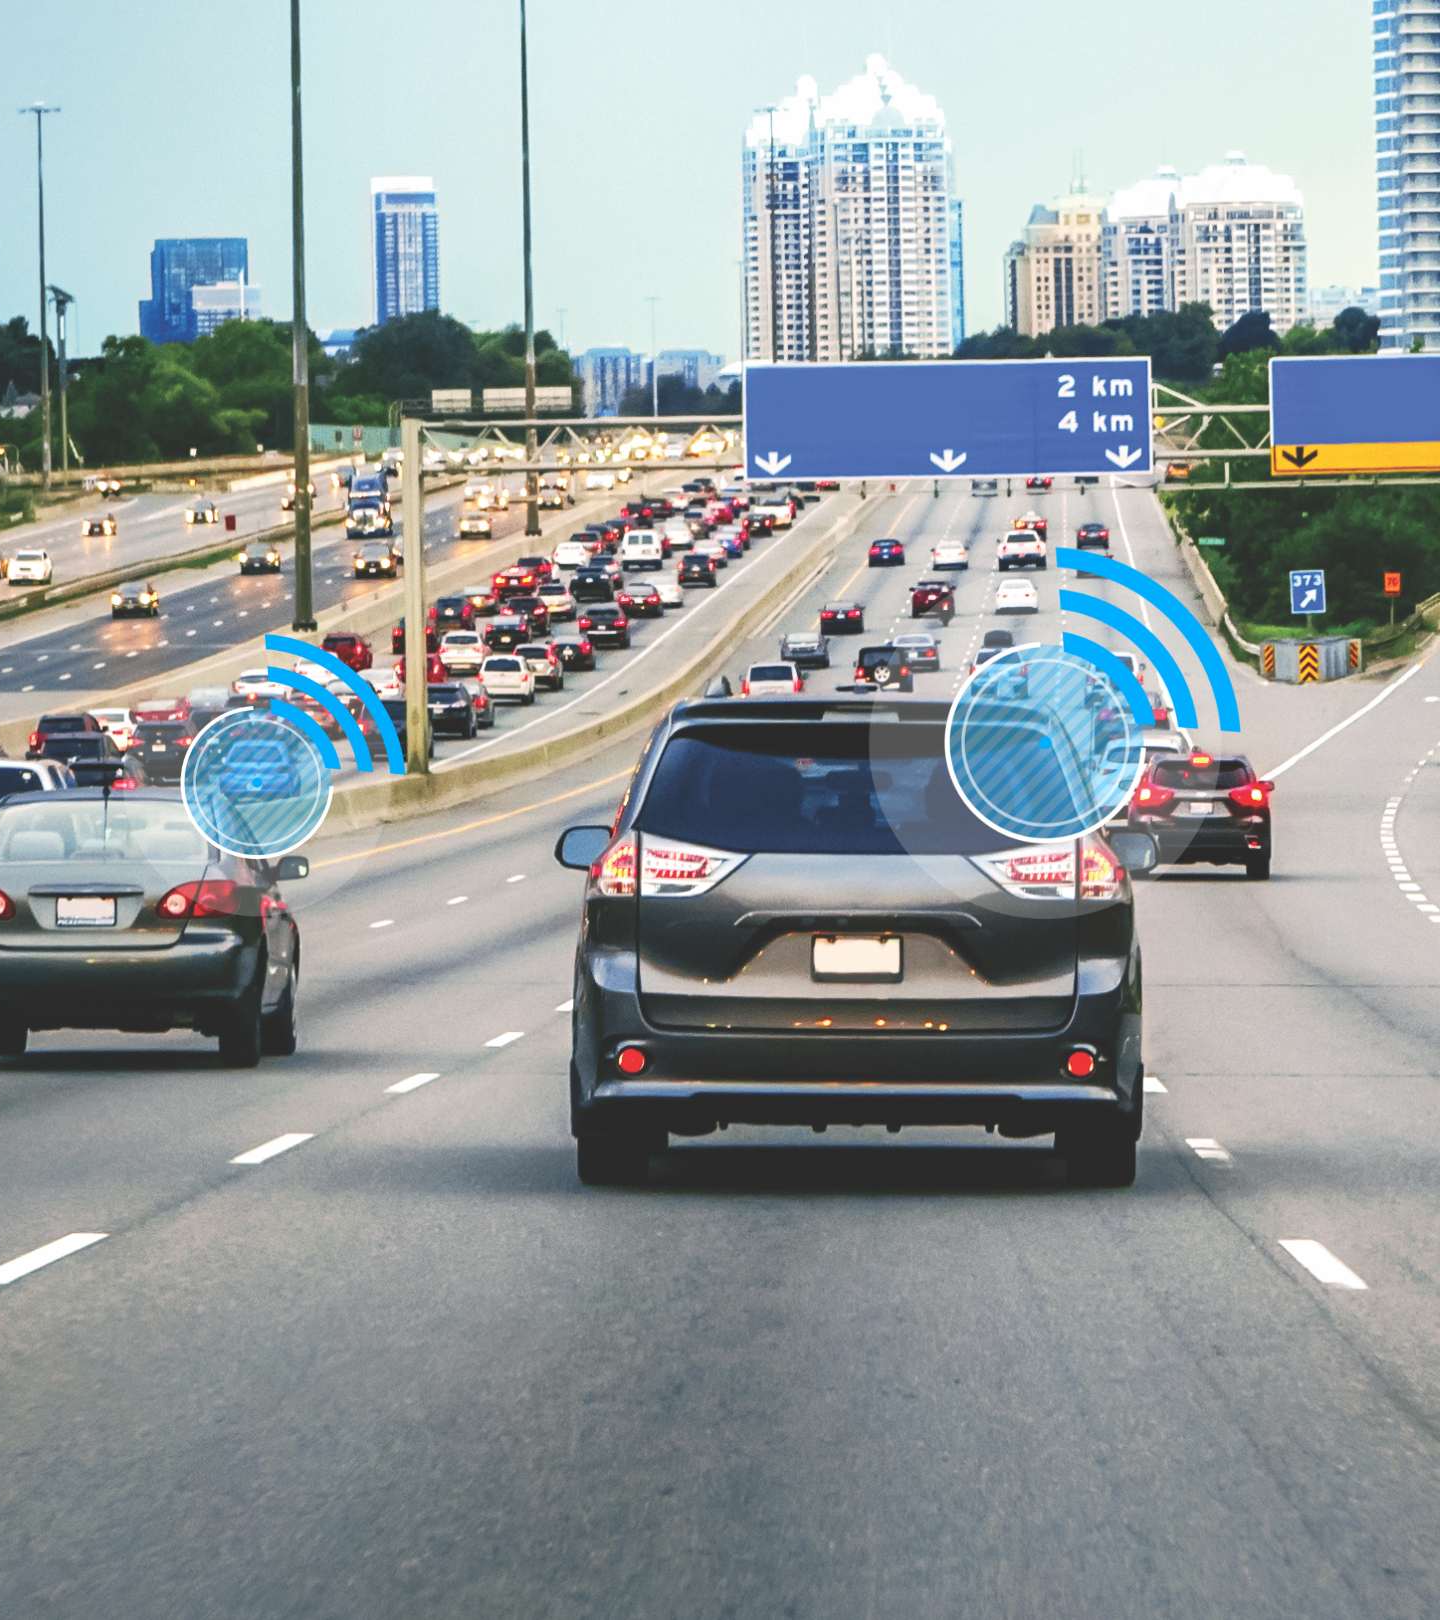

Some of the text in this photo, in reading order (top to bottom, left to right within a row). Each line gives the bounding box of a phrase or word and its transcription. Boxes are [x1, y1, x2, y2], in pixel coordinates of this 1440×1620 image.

[1058, 374, 1133, 397] 2 km
[1058, 410, 1133, 432] 4 km
[1293, 574, 1322, 587] 373
